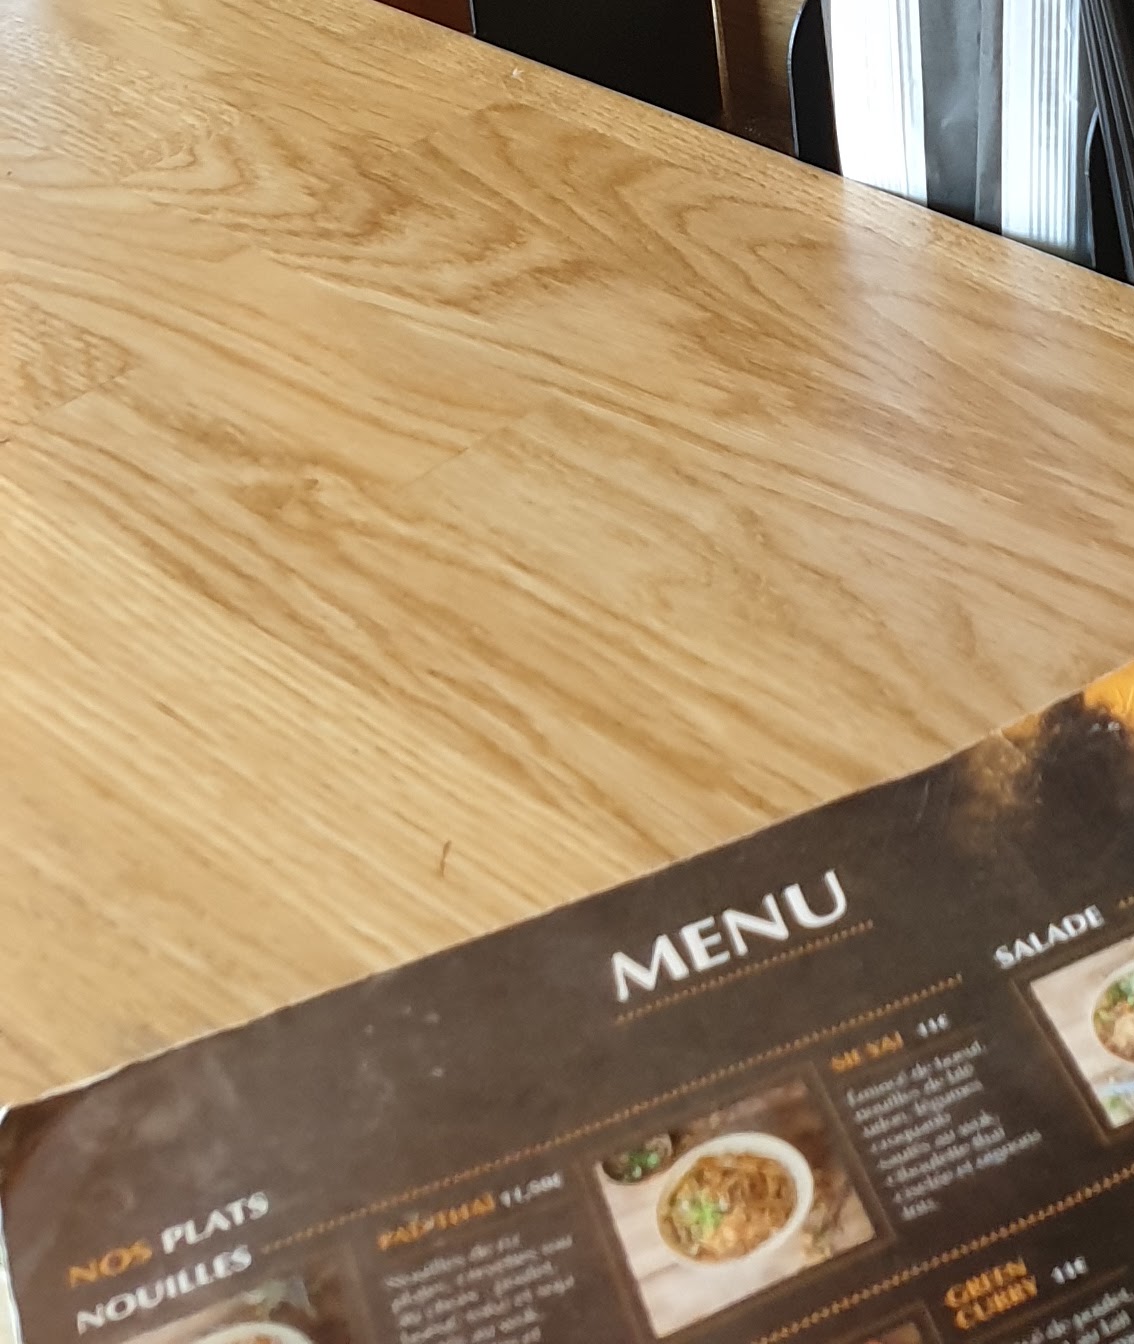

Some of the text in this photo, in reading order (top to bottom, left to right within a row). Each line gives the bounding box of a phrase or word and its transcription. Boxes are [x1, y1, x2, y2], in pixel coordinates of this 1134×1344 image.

[610, 868, 850, 1004] MENU
[993, 904, 1106, 970] SALADE
[68, 1190, 270, 1288] NOS PLATS
[76, 1244, 253, 1335] NOUILLES
